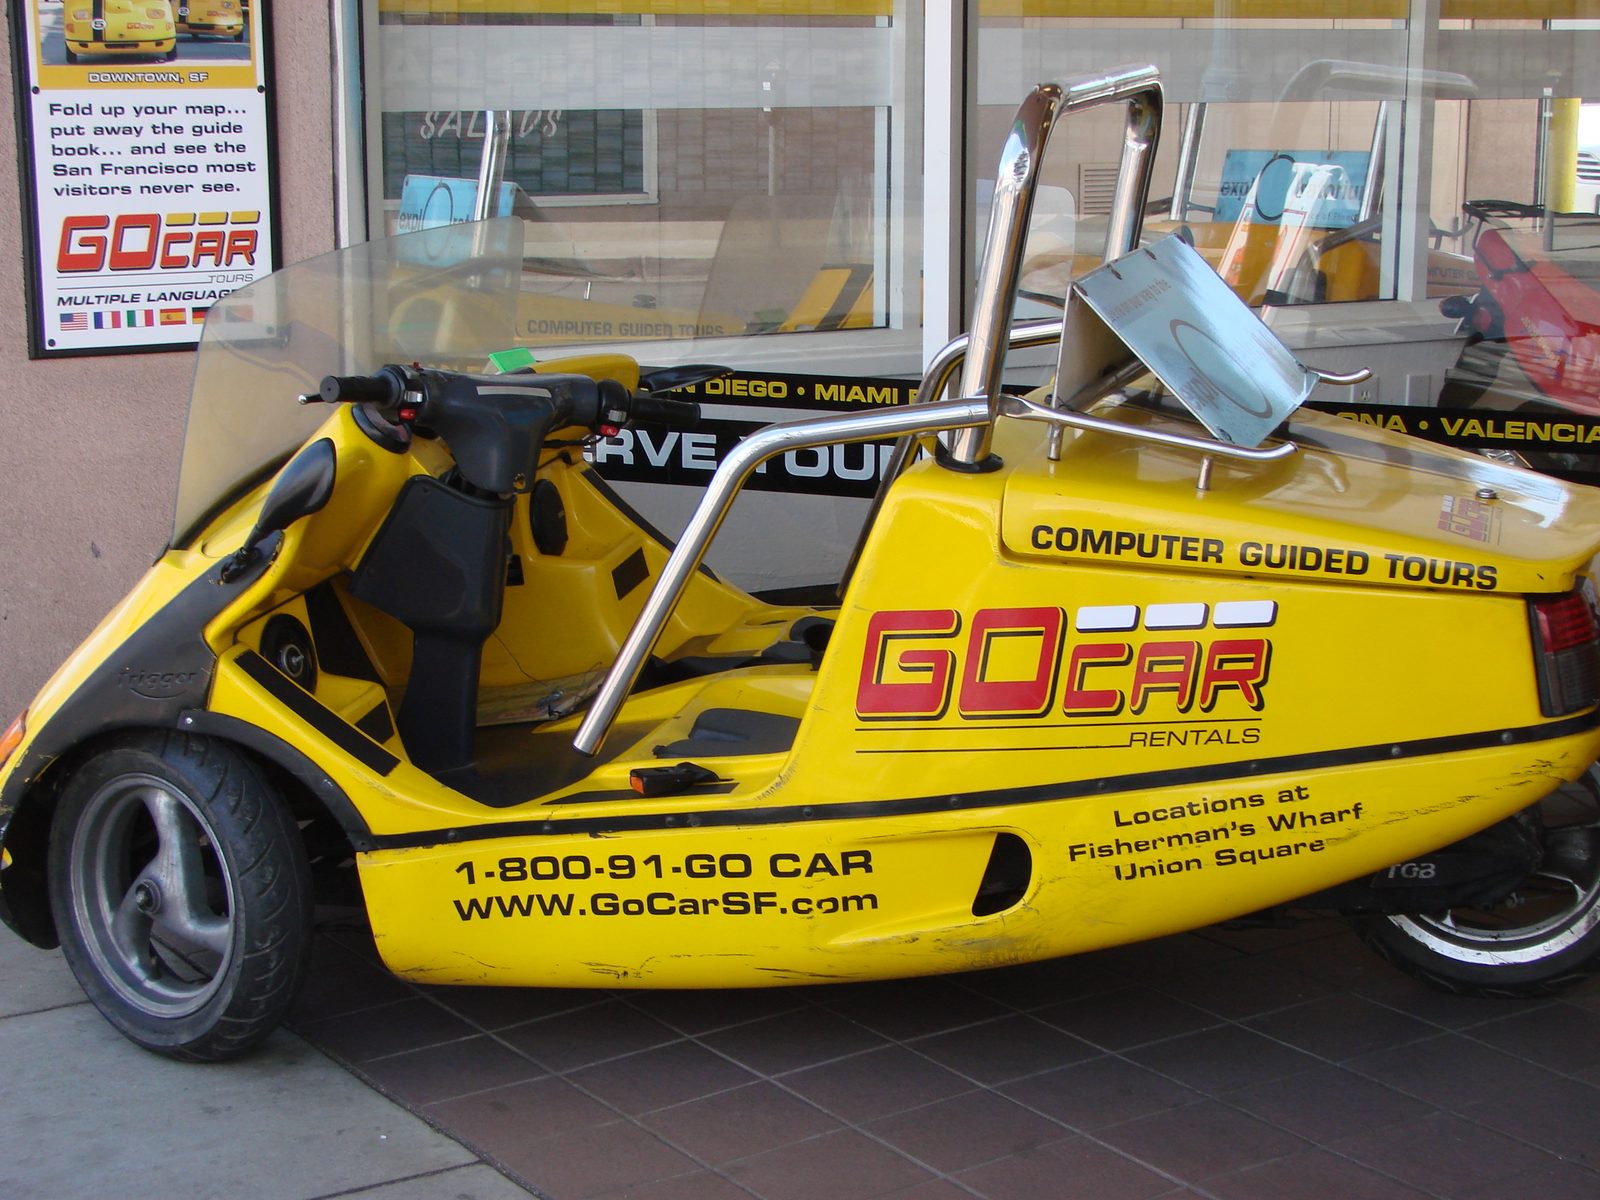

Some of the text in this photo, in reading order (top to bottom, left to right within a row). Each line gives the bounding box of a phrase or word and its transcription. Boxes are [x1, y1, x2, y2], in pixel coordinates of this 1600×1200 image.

[88, 72, 208, 84] DOWNTOWN, SF
[49, 103, 246, 118] Fold up your map...
[50, 122, 243, 139] put away the guide
[420, 111, 562, 139] SALDS
[51, 141, 246, 156] book... and see the
[53, 161, 256, 176] San Francisco most
[54, 182, 241, 196] visitors never see.
[208, 274, 253, 283] TOURS
[57, 293, 141, 307] MULTIPLE
[528, 319, 725, 337] COMPUTER GUIDED TOURS
[705, 377, 788, 398] DIEGO
[815, 383, 899, 404] MIAMI
[1031, 524, 1498, 591] COMPUTER GUIDED TOURS
[1129, 727, 1261, 748] RENTALS
[1113, 784, 1310, 827] Locations at
[1068, 802, 1363, 861] Fisherman's Wharf
[454, 849, 874, 885] 1-800-91-GO CAR
[1114, 839, 1325, 881] Union Square
[1387, 863, 1436, 879] TGB
